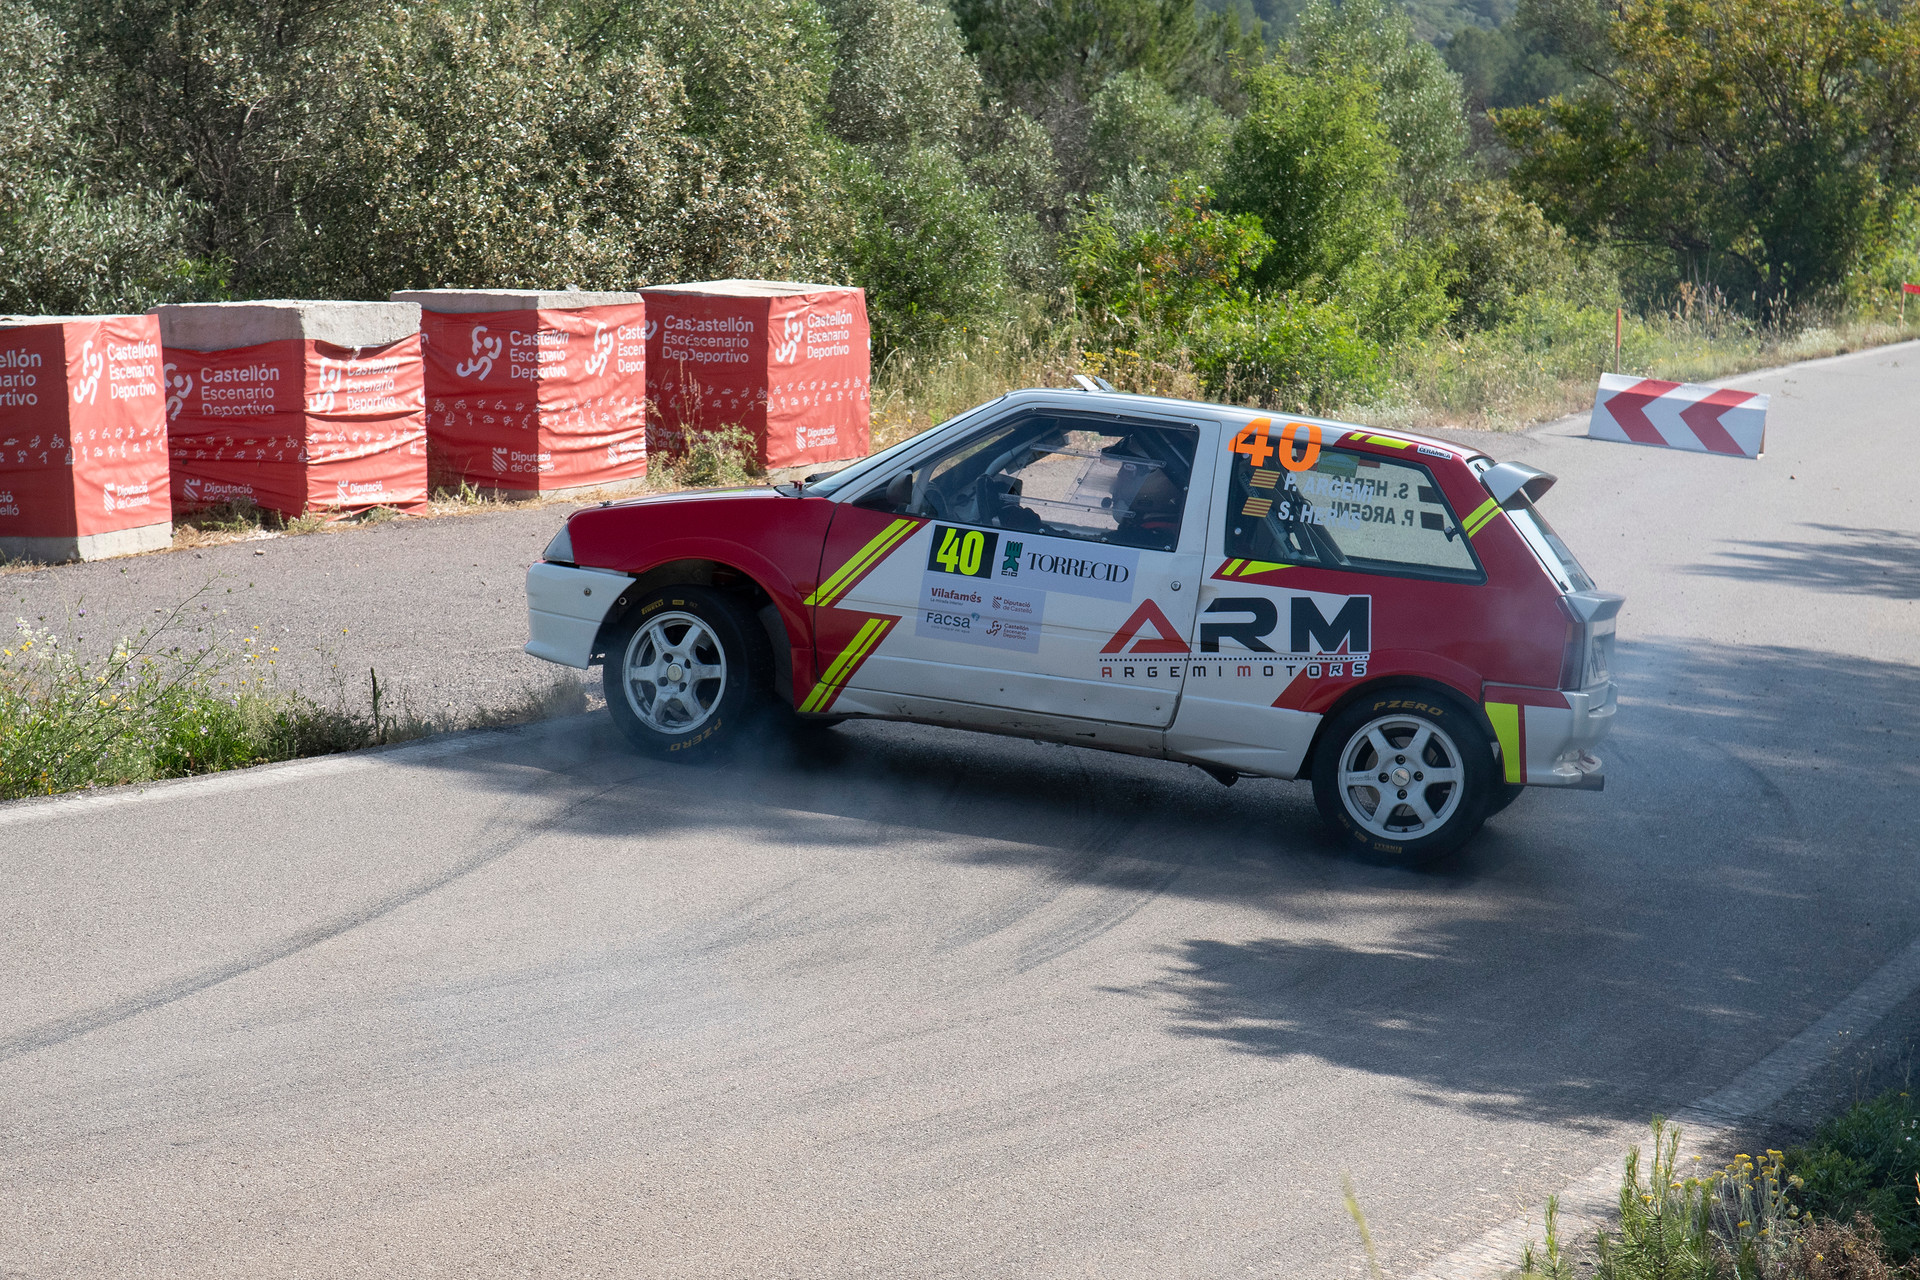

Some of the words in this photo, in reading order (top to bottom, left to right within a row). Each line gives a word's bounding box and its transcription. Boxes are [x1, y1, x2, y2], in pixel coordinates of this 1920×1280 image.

[690, 316, 754, 332] astellón
[807, 309, 852, 328] Castellón
[509, 329, 569, 346] Castellón
[807, 326, 849, 343] Escenario
[107, 339, 158, 361] Castellón
[509, 346, 566, 363] Escenario
[807, 342, 849, 360] Deportivo
[109, 360, 154, 380] Escenario
[200, 363, 280, 383] Castellón
[511, 363, 567, 381] Deportivo
[110, 379, 156, 402] Deportivo
[201, 382, 275, 401] Escenario
[346, 374, 395, 394] Escenario
[201, 400, 275, 418] Deportivo
[347, 392, 396, 412] Deportivo
[807, 425, 836, 439] Diputació
[1228, 417, 1322, 472] 40
[510, 451, 552, 464] Diputació
[510, 463, 523, 472] de
[117, 481, 148, 498] Diputació
[204, 482, 254, 495] Diputació
[350, 480, 383, 496] Diputació
[1283, 472, 1297, 491] P.
[1303, 476, 1374, 504] ARGEMI
[117, 498, 126, 509] de
[125, 494, 150, 508] Castelló
[1278, 501, 1294, 521] S.
[1300, 504, 1360, 531] HERAS
[936, 527, 985, 576] 40
[1027, 552, 1129, 583] TORRECID
[931, 587, 982, 604] Vilafamés
[1004, 599, 1030, 608] Diputació
[1010, 606, 1032, 614] Castelló
[926, 612, 971, 629] Facsa
[1004, 623, 1030, 632] Castellón
